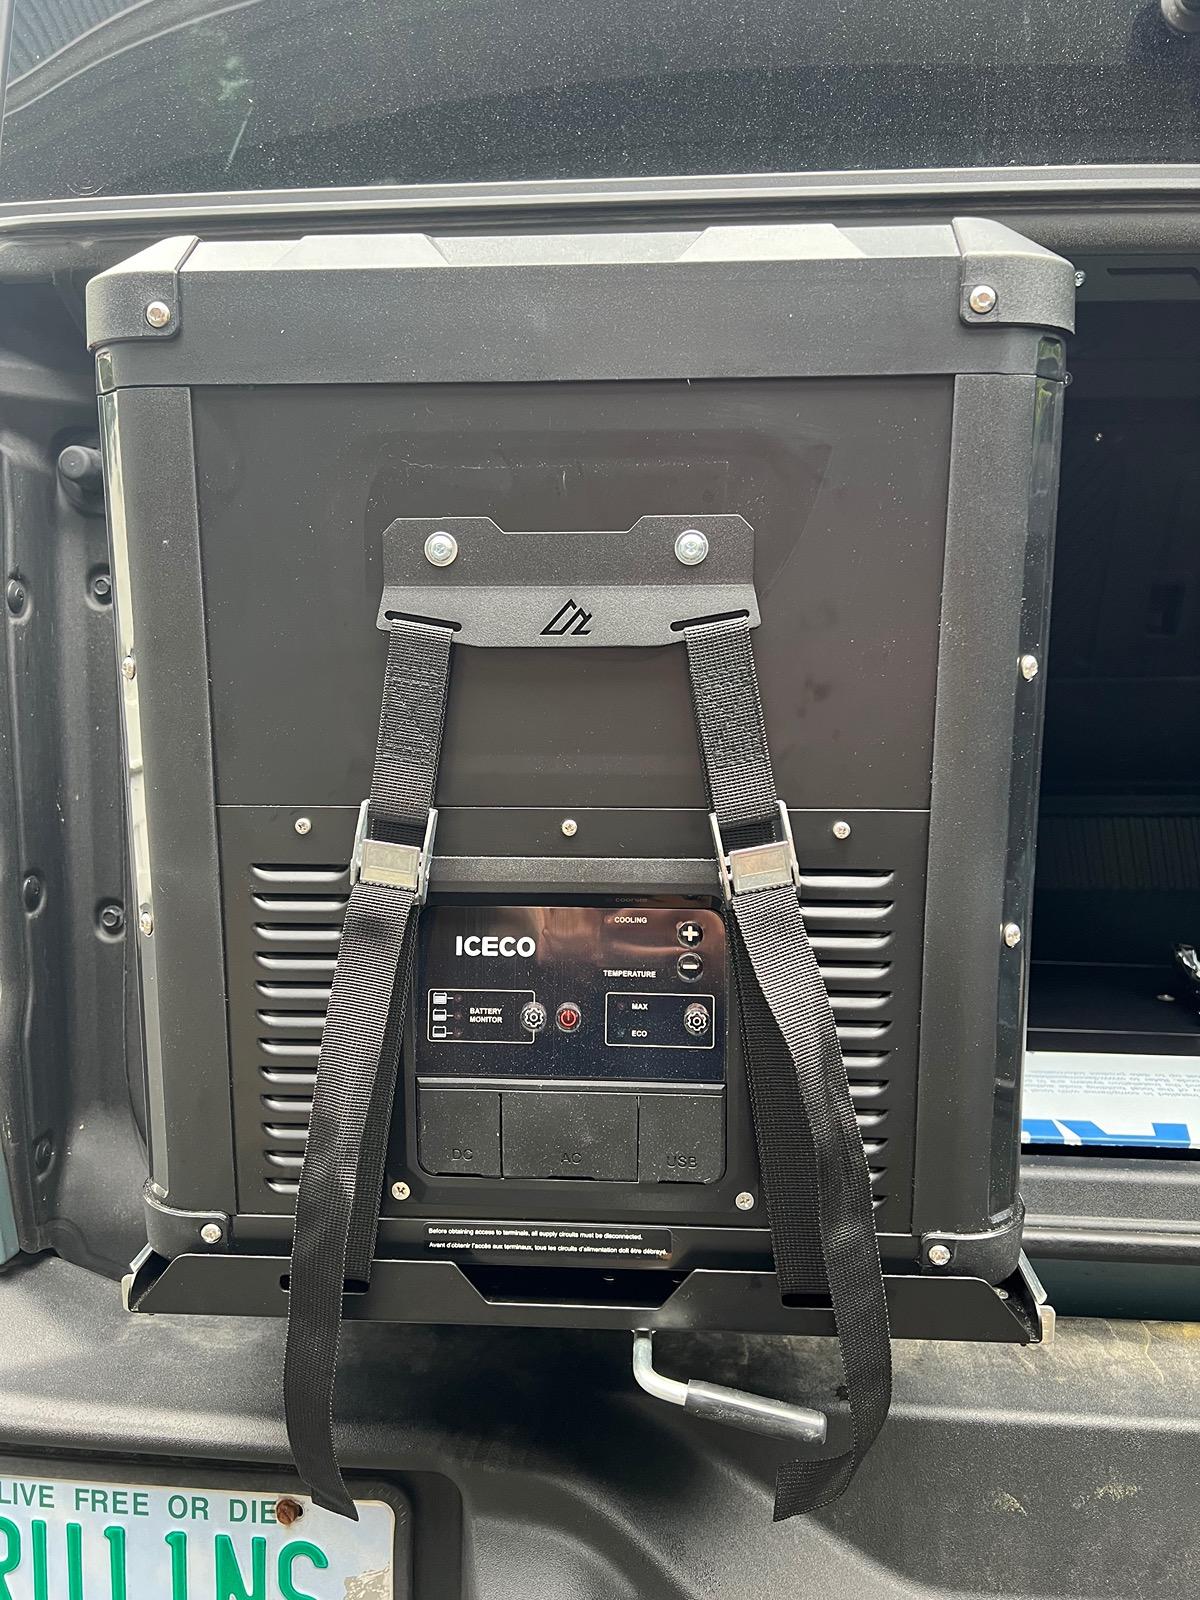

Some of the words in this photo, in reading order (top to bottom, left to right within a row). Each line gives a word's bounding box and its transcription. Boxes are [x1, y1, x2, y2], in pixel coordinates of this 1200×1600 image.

[614, 916, 647, 924] COOLING
[455, 936, 536, 958] ICECO
[603, 969, 656, 979] TEMPERATURE
[469, 1007, 502, 1015] BATTERY
[631, 1002, 648, 1011] MAX
[469, 1015, 503, 1024] MONITOR
[631, 1029, 648, 1038] ECO
[452, 1148, 473, 1161] DC
[560, 1152, 583, 1165] AC
[666, 1155, 698, 1169] USB
[448, 1228, 474, 1236] obtaining
[0, 1481, 55, 1508] LIVE
[75, 1487, 150, 1516] FREE
[167, 1494, 210, 1521] OR
[229, 1498, 278, 1524] DIE
